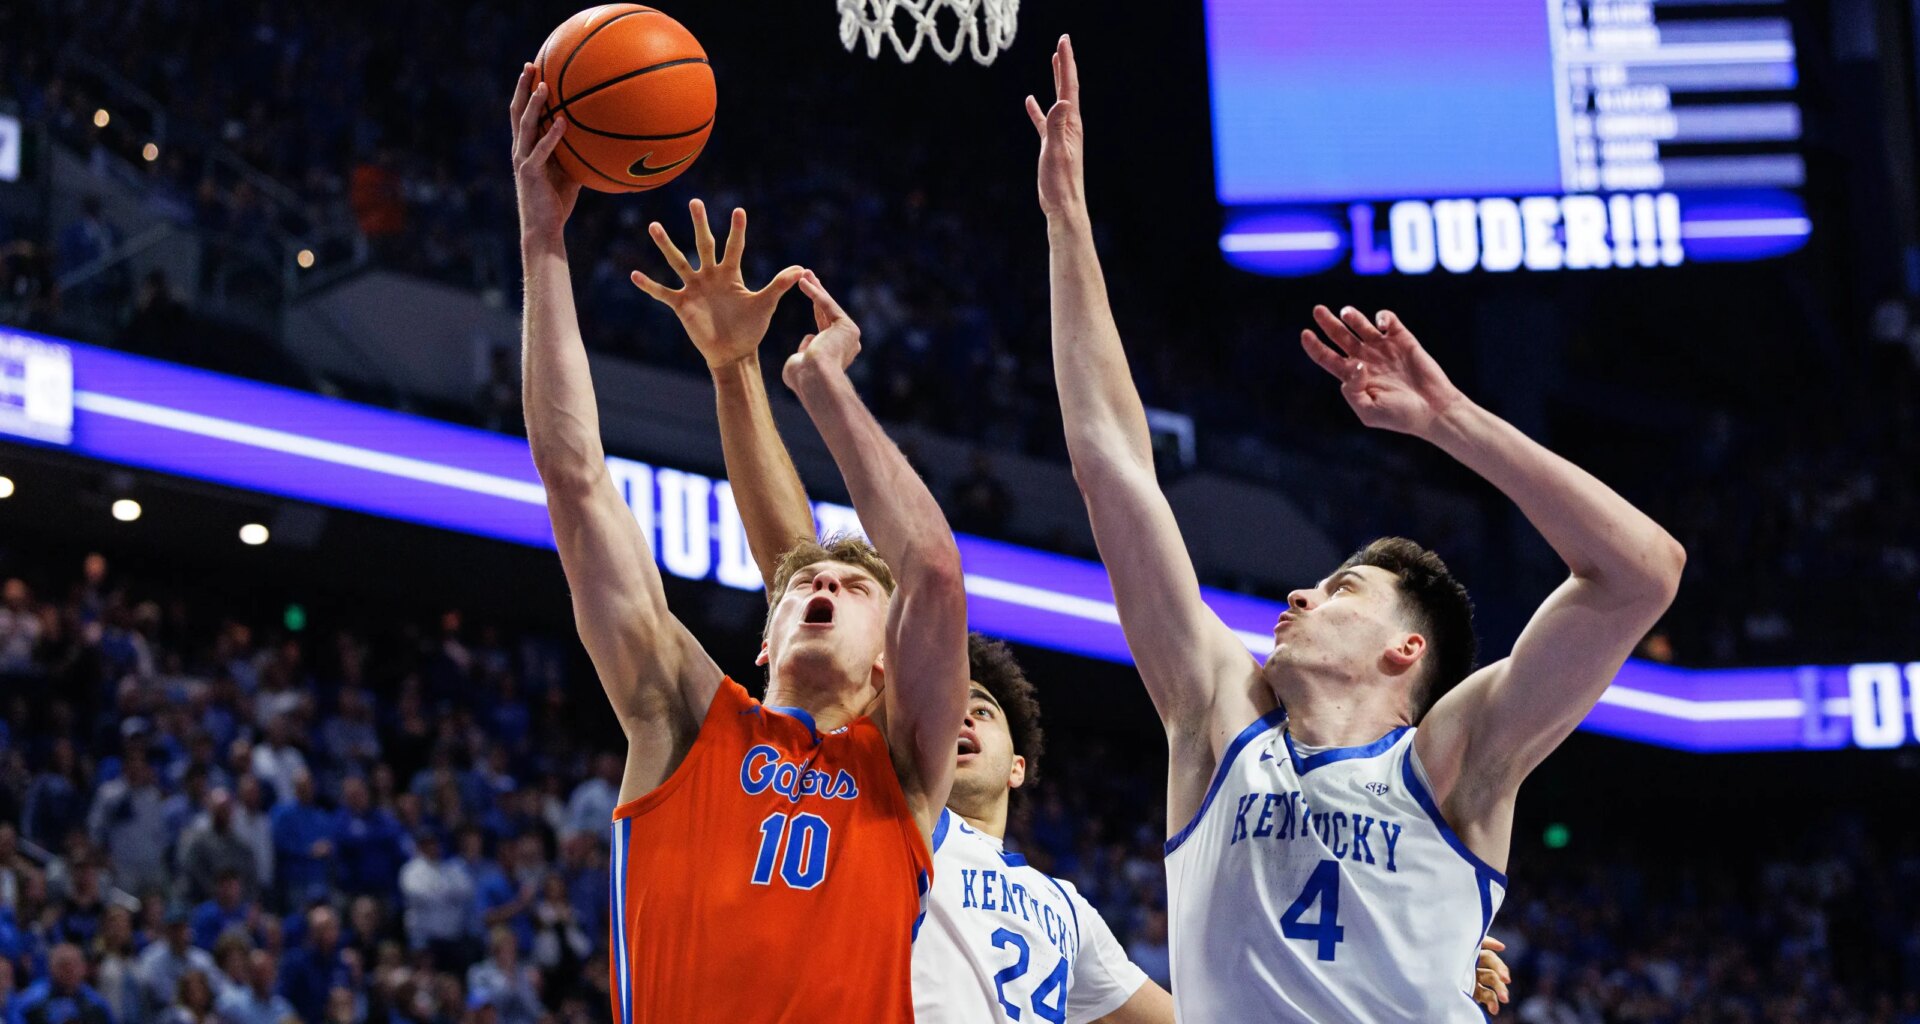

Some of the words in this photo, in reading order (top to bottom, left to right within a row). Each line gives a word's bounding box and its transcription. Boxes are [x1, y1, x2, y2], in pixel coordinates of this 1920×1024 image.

[1350, 193, 1684, 275] LOUDER!!!
[751, 811, 831, 890] 10
[1279, 859, 1344, 961] 4
[991, 926, 1069, 1024] 24
